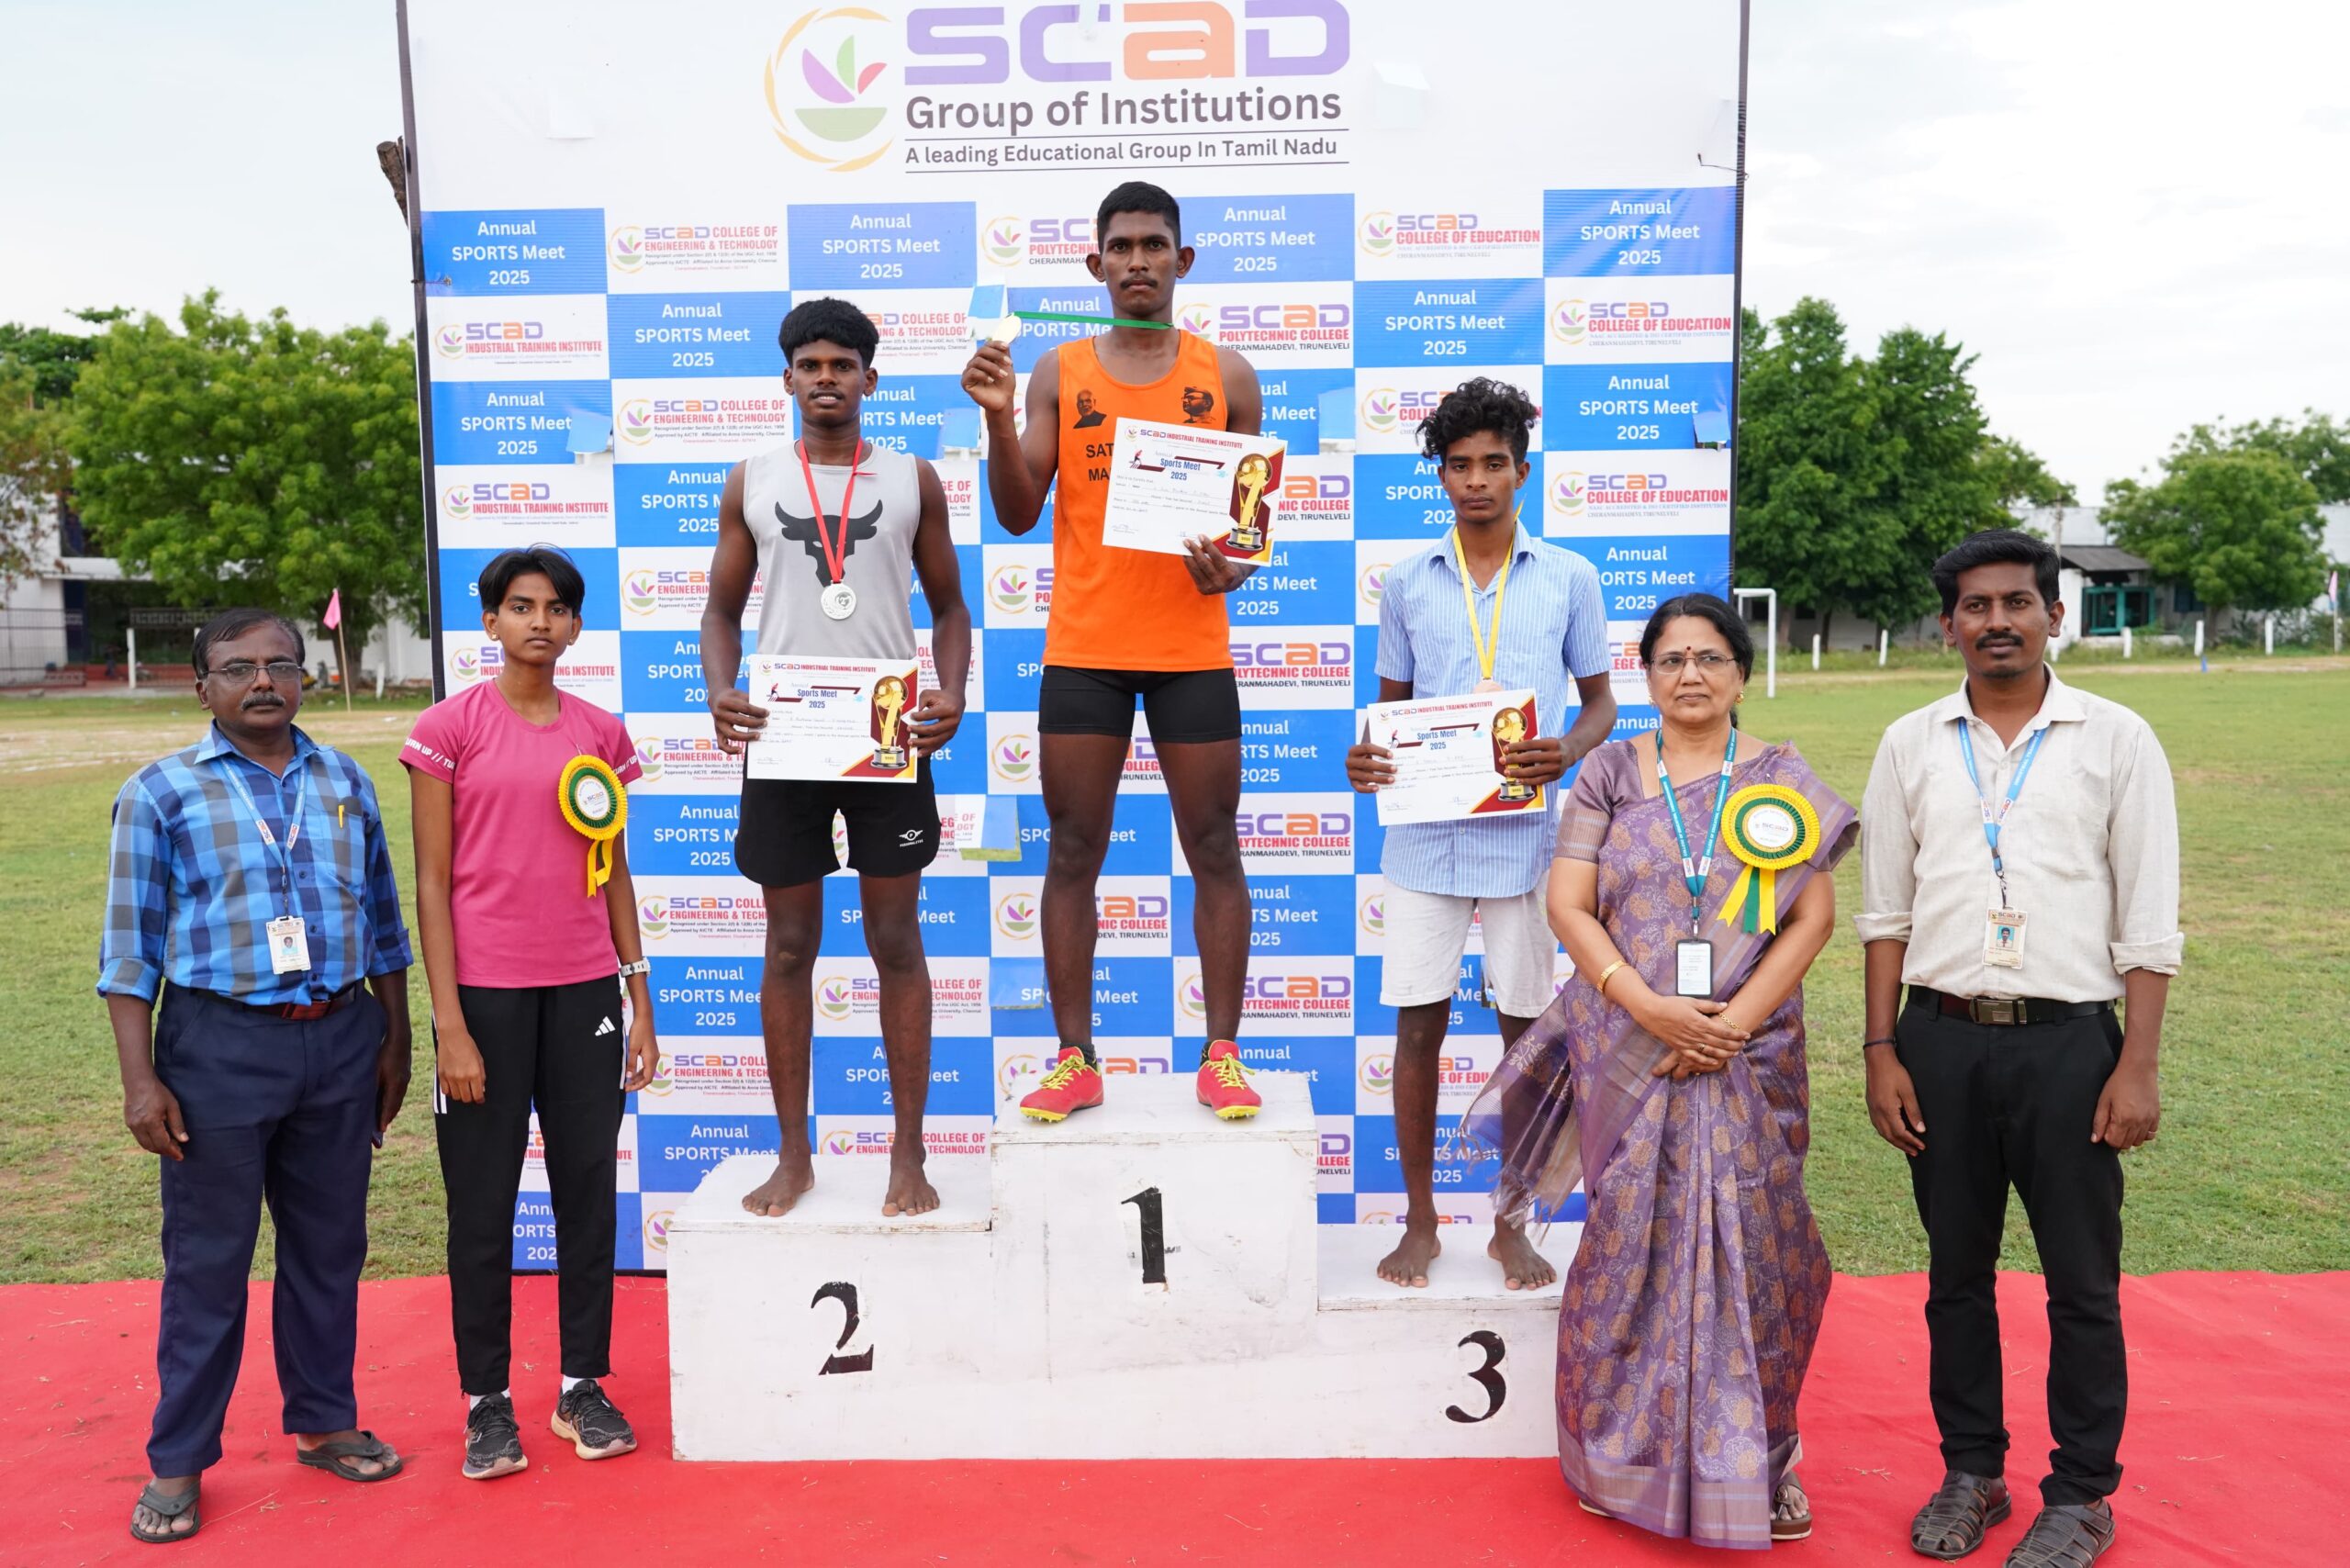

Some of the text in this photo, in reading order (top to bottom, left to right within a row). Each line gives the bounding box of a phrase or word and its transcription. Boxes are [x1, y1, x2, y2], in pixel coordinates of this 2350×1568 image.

[906, 87, 1342, 136] Group of Institutions
[906, 138, 1337, 166] A leading Educational Group In Tamil Nadu
[1224, 207, 1286, 221] Annual
[1609, 200, 1671, 215] Annual
[477, 220, 536, 236] Annual
[850, 214, 911, 230] Annual
[712, 227, 760, 237] COLLEGE
[764, 227, 778, 237] OF
[1195, 231, 1315, 247] SPORTS Meet
[1396, 230, 1540, 244] COLLEGE OF EDUCATION
[1581, 225, 1700, 241] SPORTS Meet
[452, 244, 565, 261] SPORTS Meet
[644, 240, 778, 251] ENGINEERING & TECHNOLOGY
[822, 239, 940, 254] SPORTS Meet
[1234, 257, 1277, 272] 2025
[1617, 251, 1661, 265] 2025
[489, 271, 530, 285] 2025
[860, 264, 902, 278] 2025
[1039, 297, 1100, 312] Annual
[1415, 290, 1476, 305] Annual
[663, 303, 722, 319] Annual
[902, 313, 949, 324] COLLEGE
[1385, 315, 1505, 330] SPORTS Meet
[1589, 318, 1731, 331] COLLEGE OF EDUCATION
[635, 328, 751, 343] SPORTS Meet
[898, 327, 967, 336] & TECHNOLOGY
[1219, 329, 1348, 342] POLYTECHNIC COLLEGE
[465, 341, 602, 353] INDUSTRIAL TRAINING INSTITUTE
[1424, 341, 1466, 355] 2025
[673, 353, 714, 367] 2025
[1607, 375, 1669, 390] Annual
[487, 392, 544, 407] Annual
[721, 400, 767, 411] COLLEGE
[772, 400, 785, 410] OF
[1275, 407, 1316, 420] Meet
[1579, 400, 1698, 416] SPORTS Meet
[461, 417, 572, 431] SPORTS Meet
[655, 413, 785, 423] ENGINEERING & TECHNOLOGY
[903, 411, 943, 426] Meet
[1617, 425, 1660, 440] 2025
[498, 441, 537, 455] 2025
[1167, 433, 1194, 442] INDUSTRIAL
[1218, 440, 1243, 449] INSTITUTE
[1160, 458, 1201, 471] Sports Meet
[668, 470, 726, 484] Annual
[1171, 472, 1187, 481] 2025
[642, 495, 709, 509] SPORTS
[1587, 489, 1728, 503] COLLEGE OF EDUCATION
[473, 502, 609, 513] INDUSTRIAL TRAINING INSTITUTE
[1302, 499, 1349, 510] COLLEGE
[678, 519, 719, 532] 2025
[1606, 547, 1667, 561] Annual
[1273, 577, 1316, 590] Meet
[1651, 571, 1695, 585] Meet
[1237, 602, 1279, 616] 2025
[1615, 596, 1657, 610] 2025
[572, 666, 615, 677] INSTITUTE
[1303, 666, 1350, 678] COLLEGE
[798, 689, 819, 698] Sports
[809, 700, 825, 709] 2025
[1417, 700, 1493, 713] INDUSTRIAL TRAINING INSTITUTE
[1417, 730, 1457, 741] Sports Meet
[1274, 745, 1317, 758] Meet
[1429, 742, 1446, 750] 2025
[664, 752, 722, 761] ENGINEERING
[1240, 768, 1280, 782] 2025
[679, 805, 738, 820] Annual
[654, 828, 721, 843] SPORTS
[1303, 836, 1350, 847] COLLEGE
[690, 852, 730, 866] 2025
[670, 911, 738, 920] ENGINEERING &
[1274, 909, 1317, 923] Meet
[1120, 919, 1167, 929] COLLEGE
[685, 966, 744, 981] Annual
[968, 980, 981, 989] OF
[659, 989, 724, 1003] SPORTS
[1096, 990, 1137, 1003] Meet
[1303, 999, 1350, 1010] COLLEGE
[696, 1012, 736, 1026] 2025
[674, 1069, 743, 1077] ENGINEERING &
[690, 1125, 749, 1139] Annual
[923, 1133, 985, 1143] COLLEGE OF
[665, 1147, 730, 1161] SPORTS
[928, 1145, 985, 1155] TECHNOLOGY
[1121, 1185, 1167, 1284] 1
[810, 1281, 875, 1375] 2
[1445, 1329, 1507, 1423] 3
